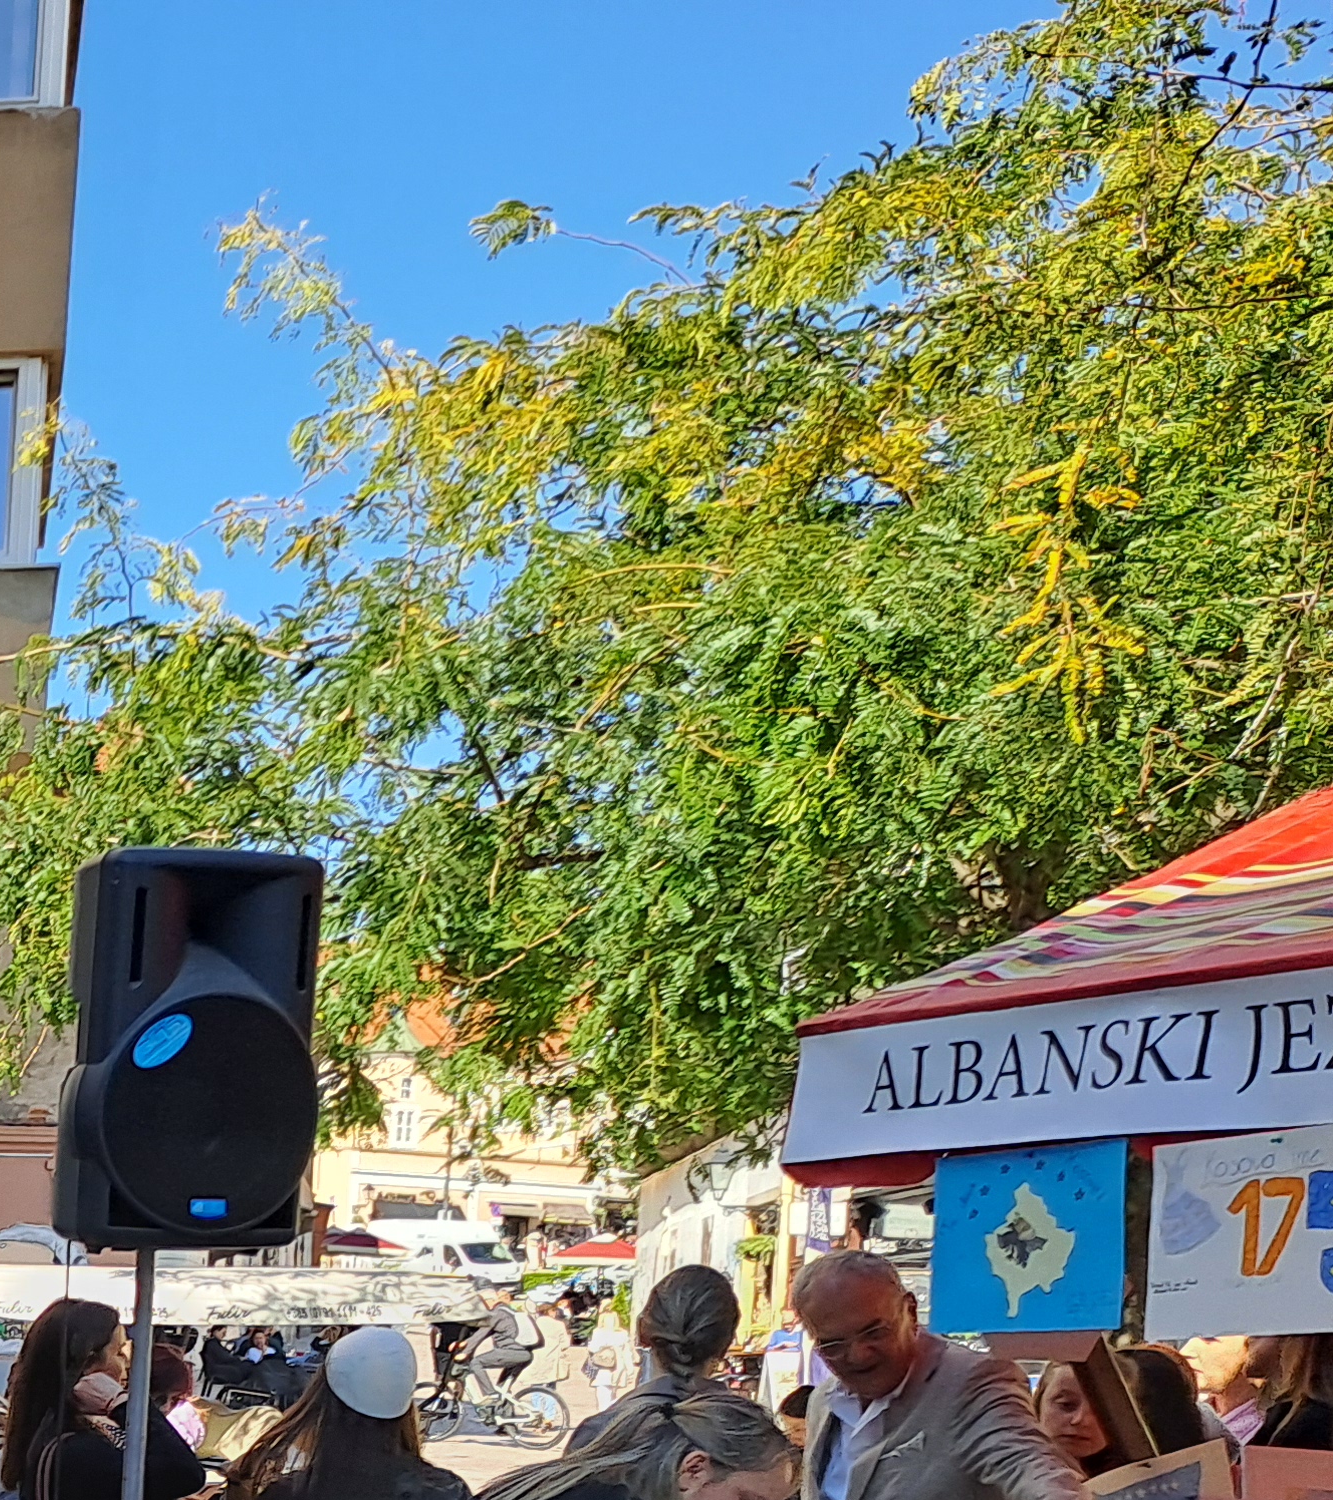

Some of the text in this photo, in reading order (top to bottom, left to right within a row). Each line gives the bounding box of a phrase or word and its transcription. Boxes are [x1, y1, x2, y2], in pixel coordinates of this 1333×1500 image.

[862, 998, 1333, 1114] ALBANSKI JE
[1227, 1178, 1306, 1277] 17
